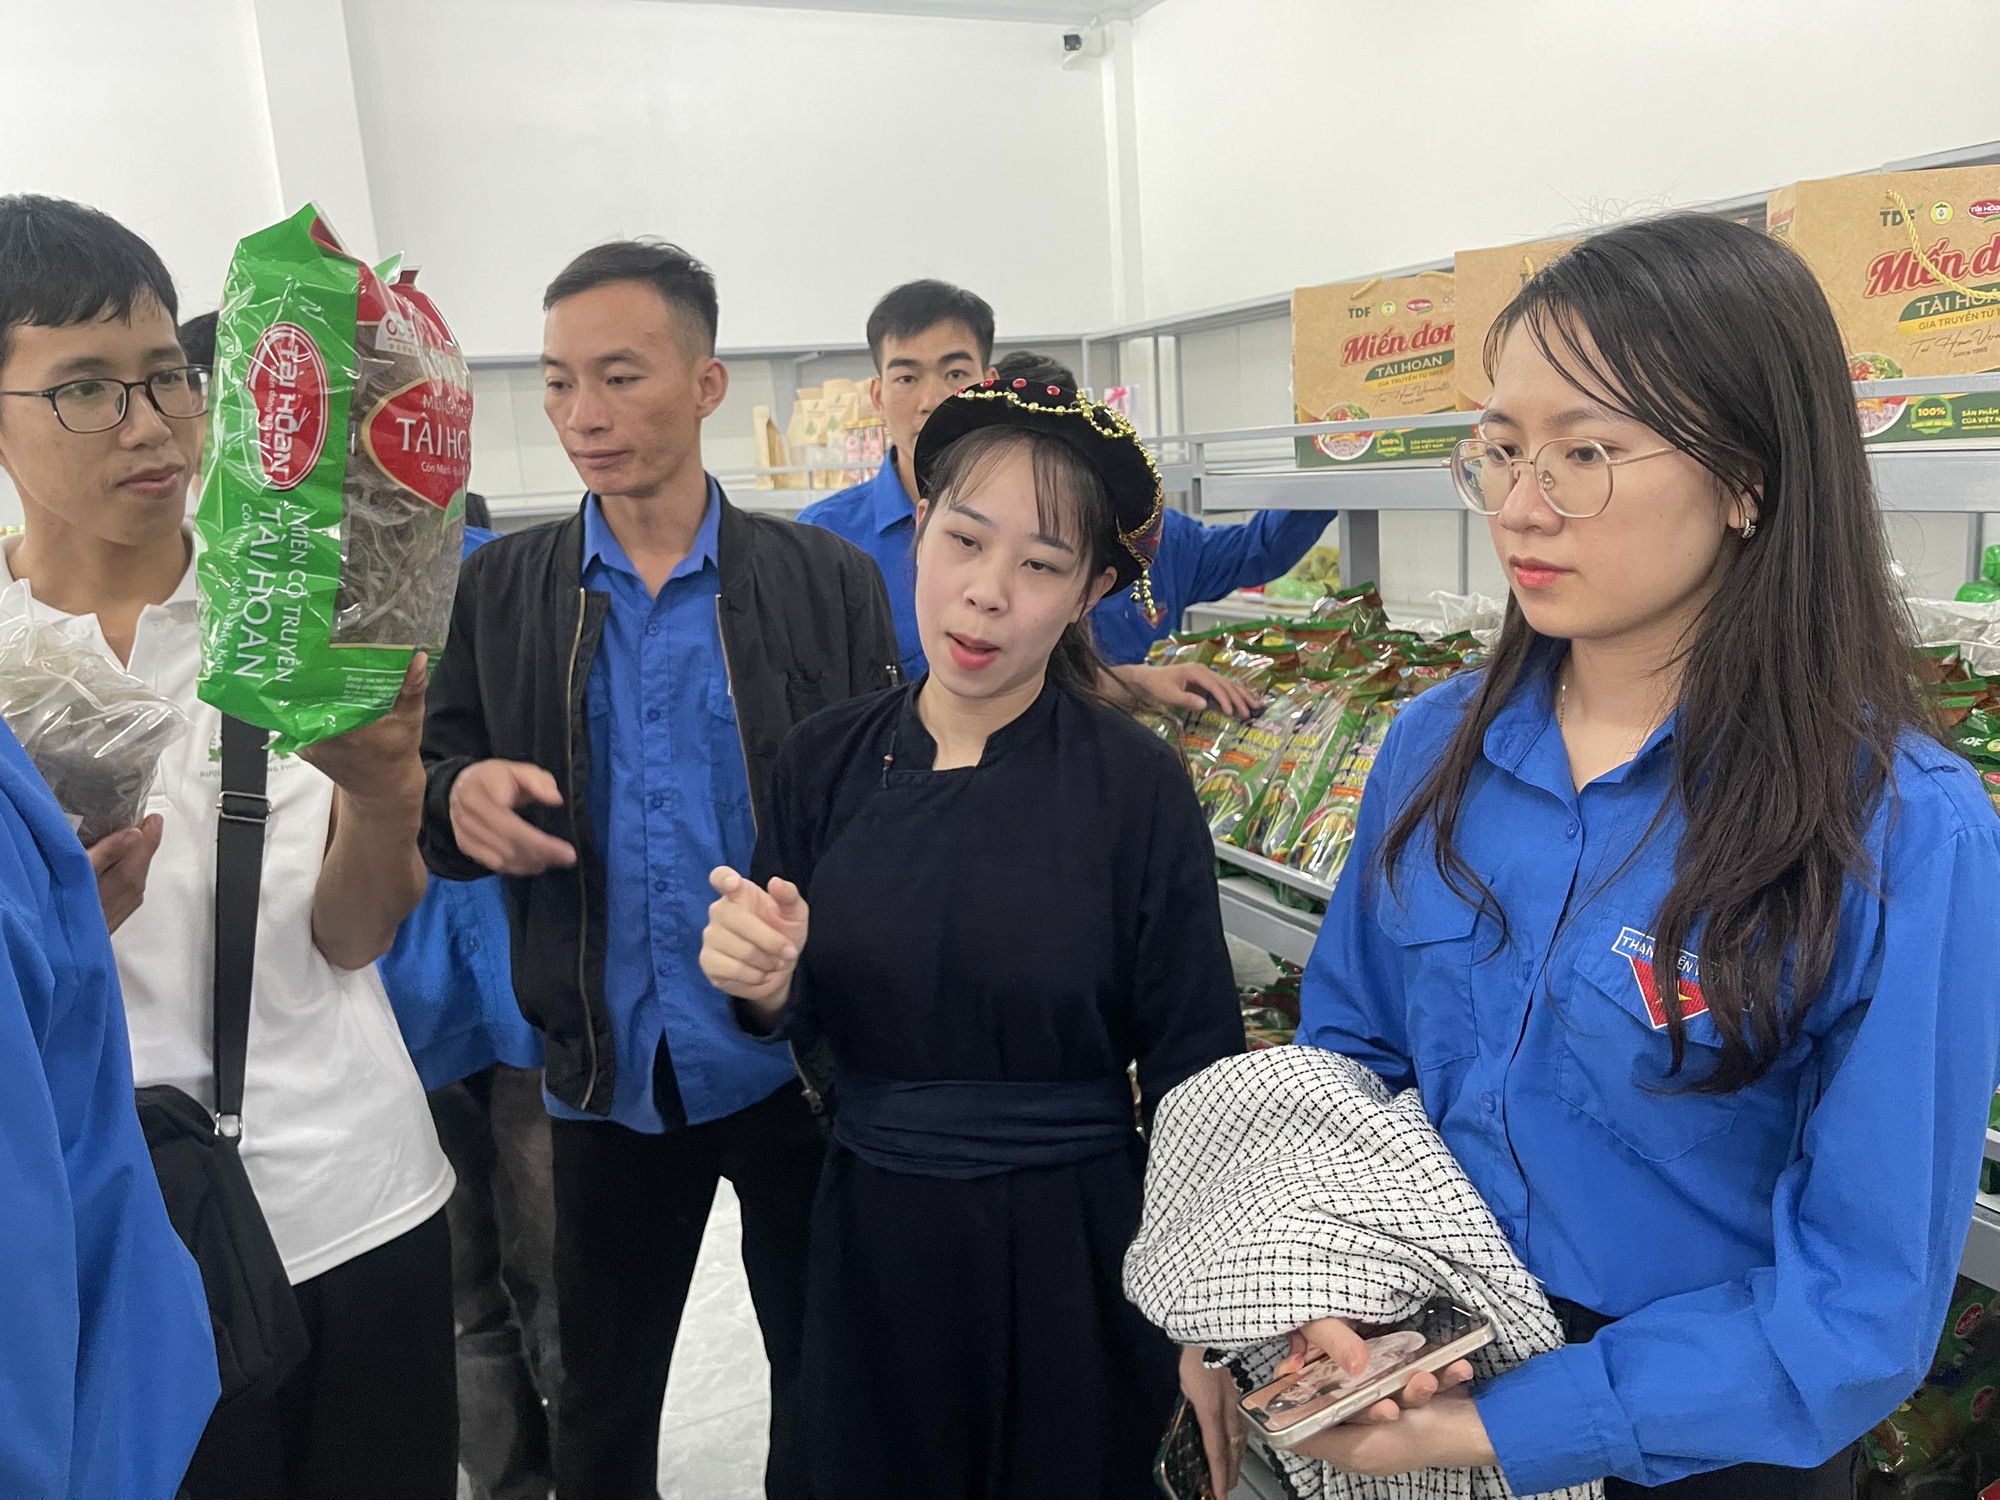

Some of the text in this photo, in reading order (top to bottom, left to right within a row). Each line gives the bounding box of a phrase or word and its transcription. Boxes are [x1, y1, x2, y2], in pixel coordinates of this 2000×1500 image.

[1348, 306, 1371, 319] TDF
[1918, 320, 1937, 331] GIA
[1341, 324, 1409, 367] Miến
[1375, 355, 1443, 378] TÀI HOAN
[1918, 407, 1946, 417] 100%
[230, 533, 249, 564] Minh
[233, 507, 287, 680] TÀI HOAN
[274, 605, 303, 682] TRUYỀN
[1623, 936, 1654, 958] THAN
